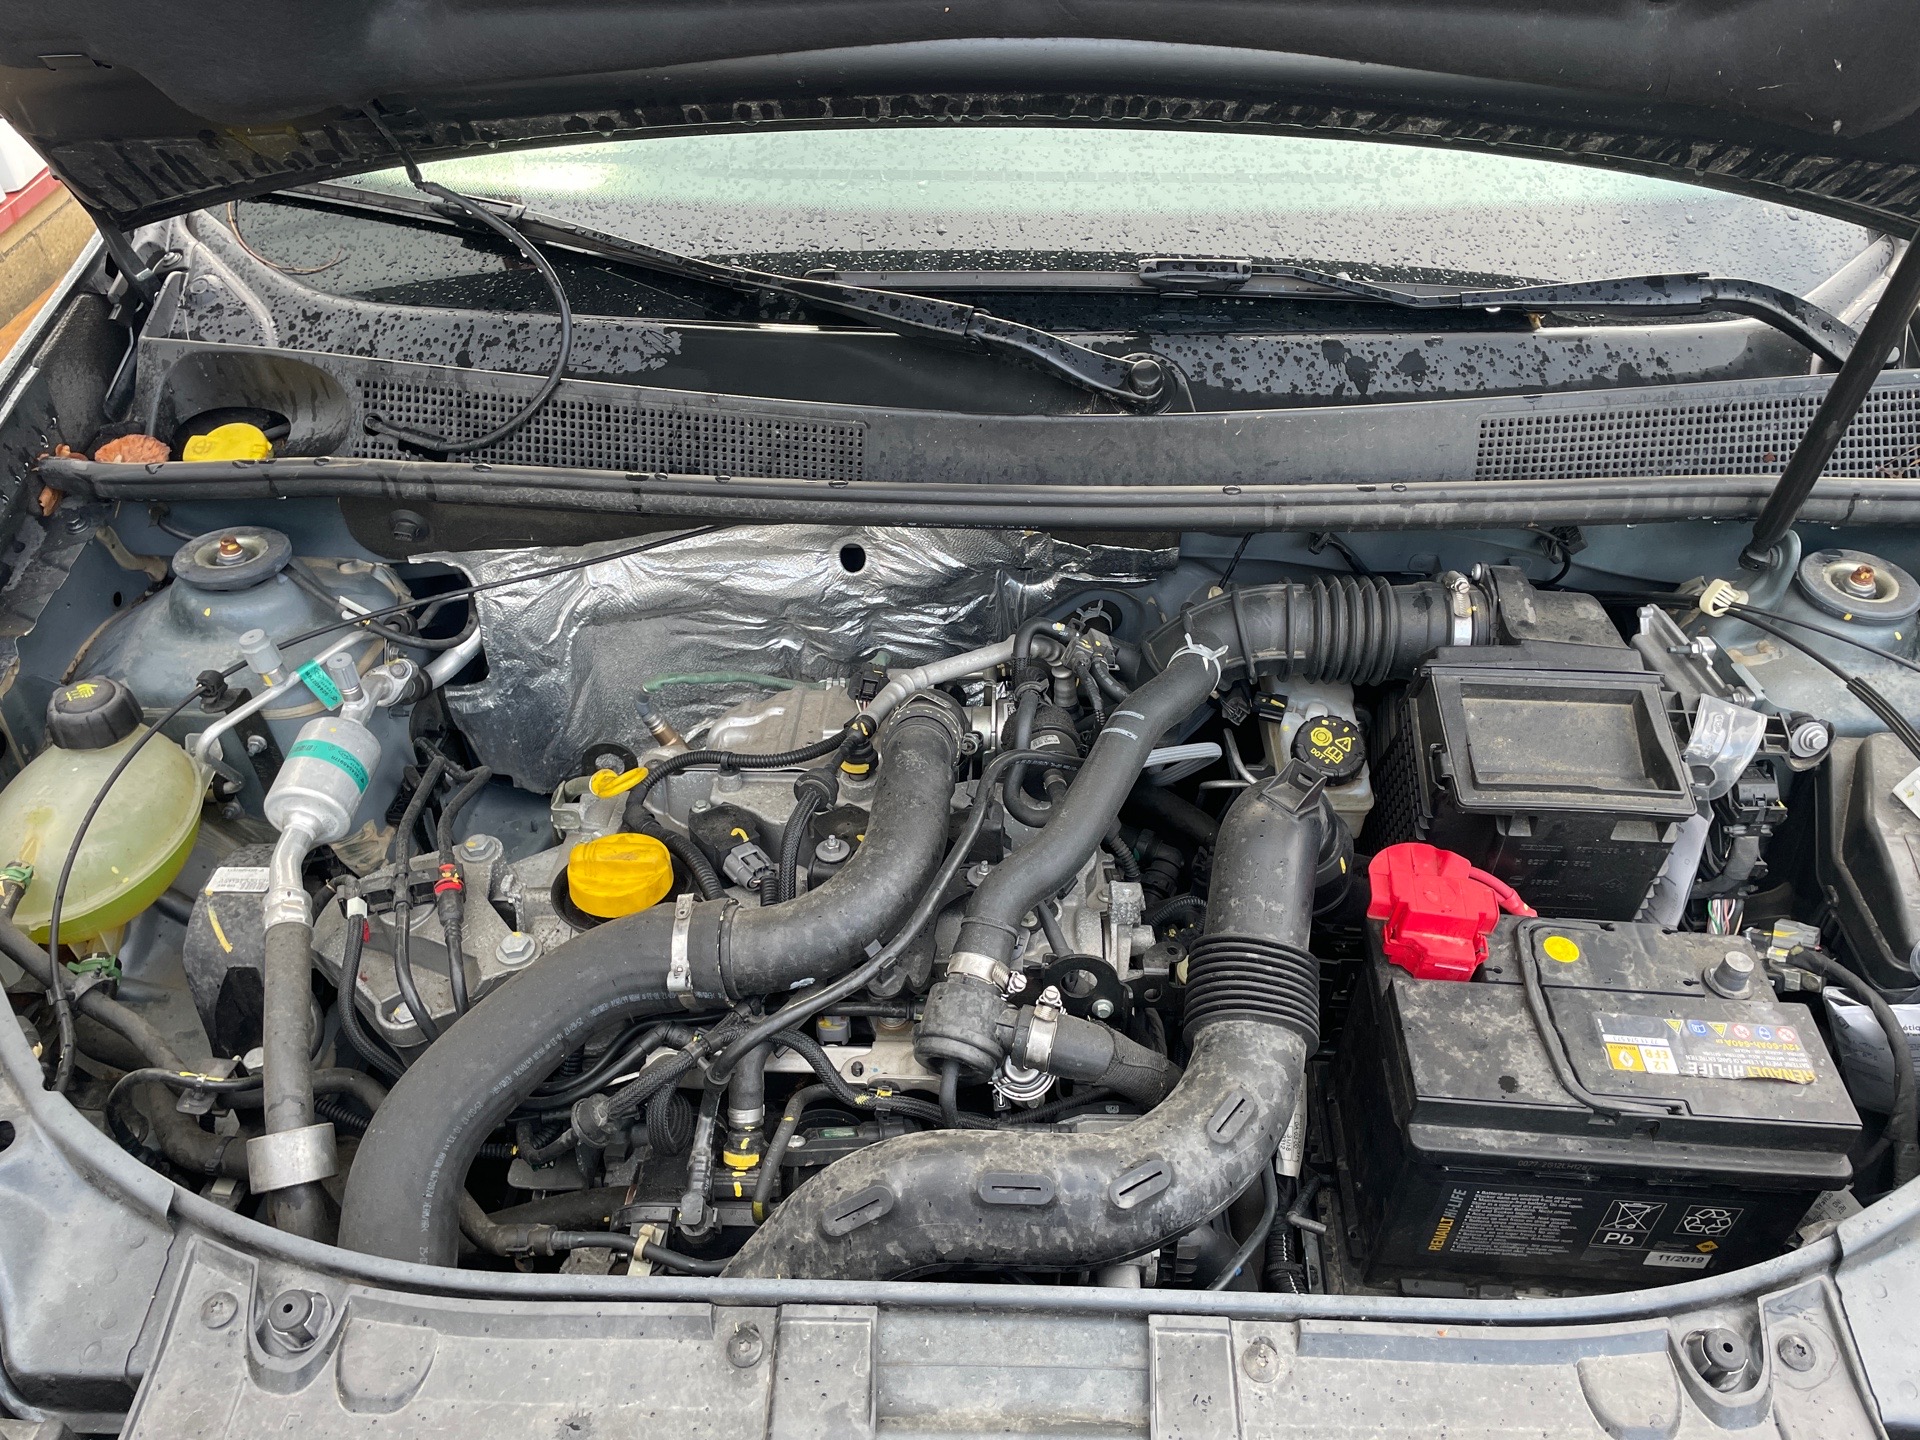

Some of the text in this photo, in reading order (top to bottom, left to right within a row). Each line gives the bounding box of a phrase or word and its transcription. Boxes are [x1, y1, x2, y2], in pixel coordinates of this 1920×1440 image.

[1310, 748, 1325, 760] DOT
[1644, 1048, 1668, 1059] EFB
[1653, 1060, 1668, 1070] L2
[1746, 1066, 1815, 1084] RENAULT
[1428, 1188, 1467, 1252] RENAULT Hi-LIFE
[1602, 1232, 1634, 1245] Pb
[1658, 1254, 1704, 1264] 11/2019
